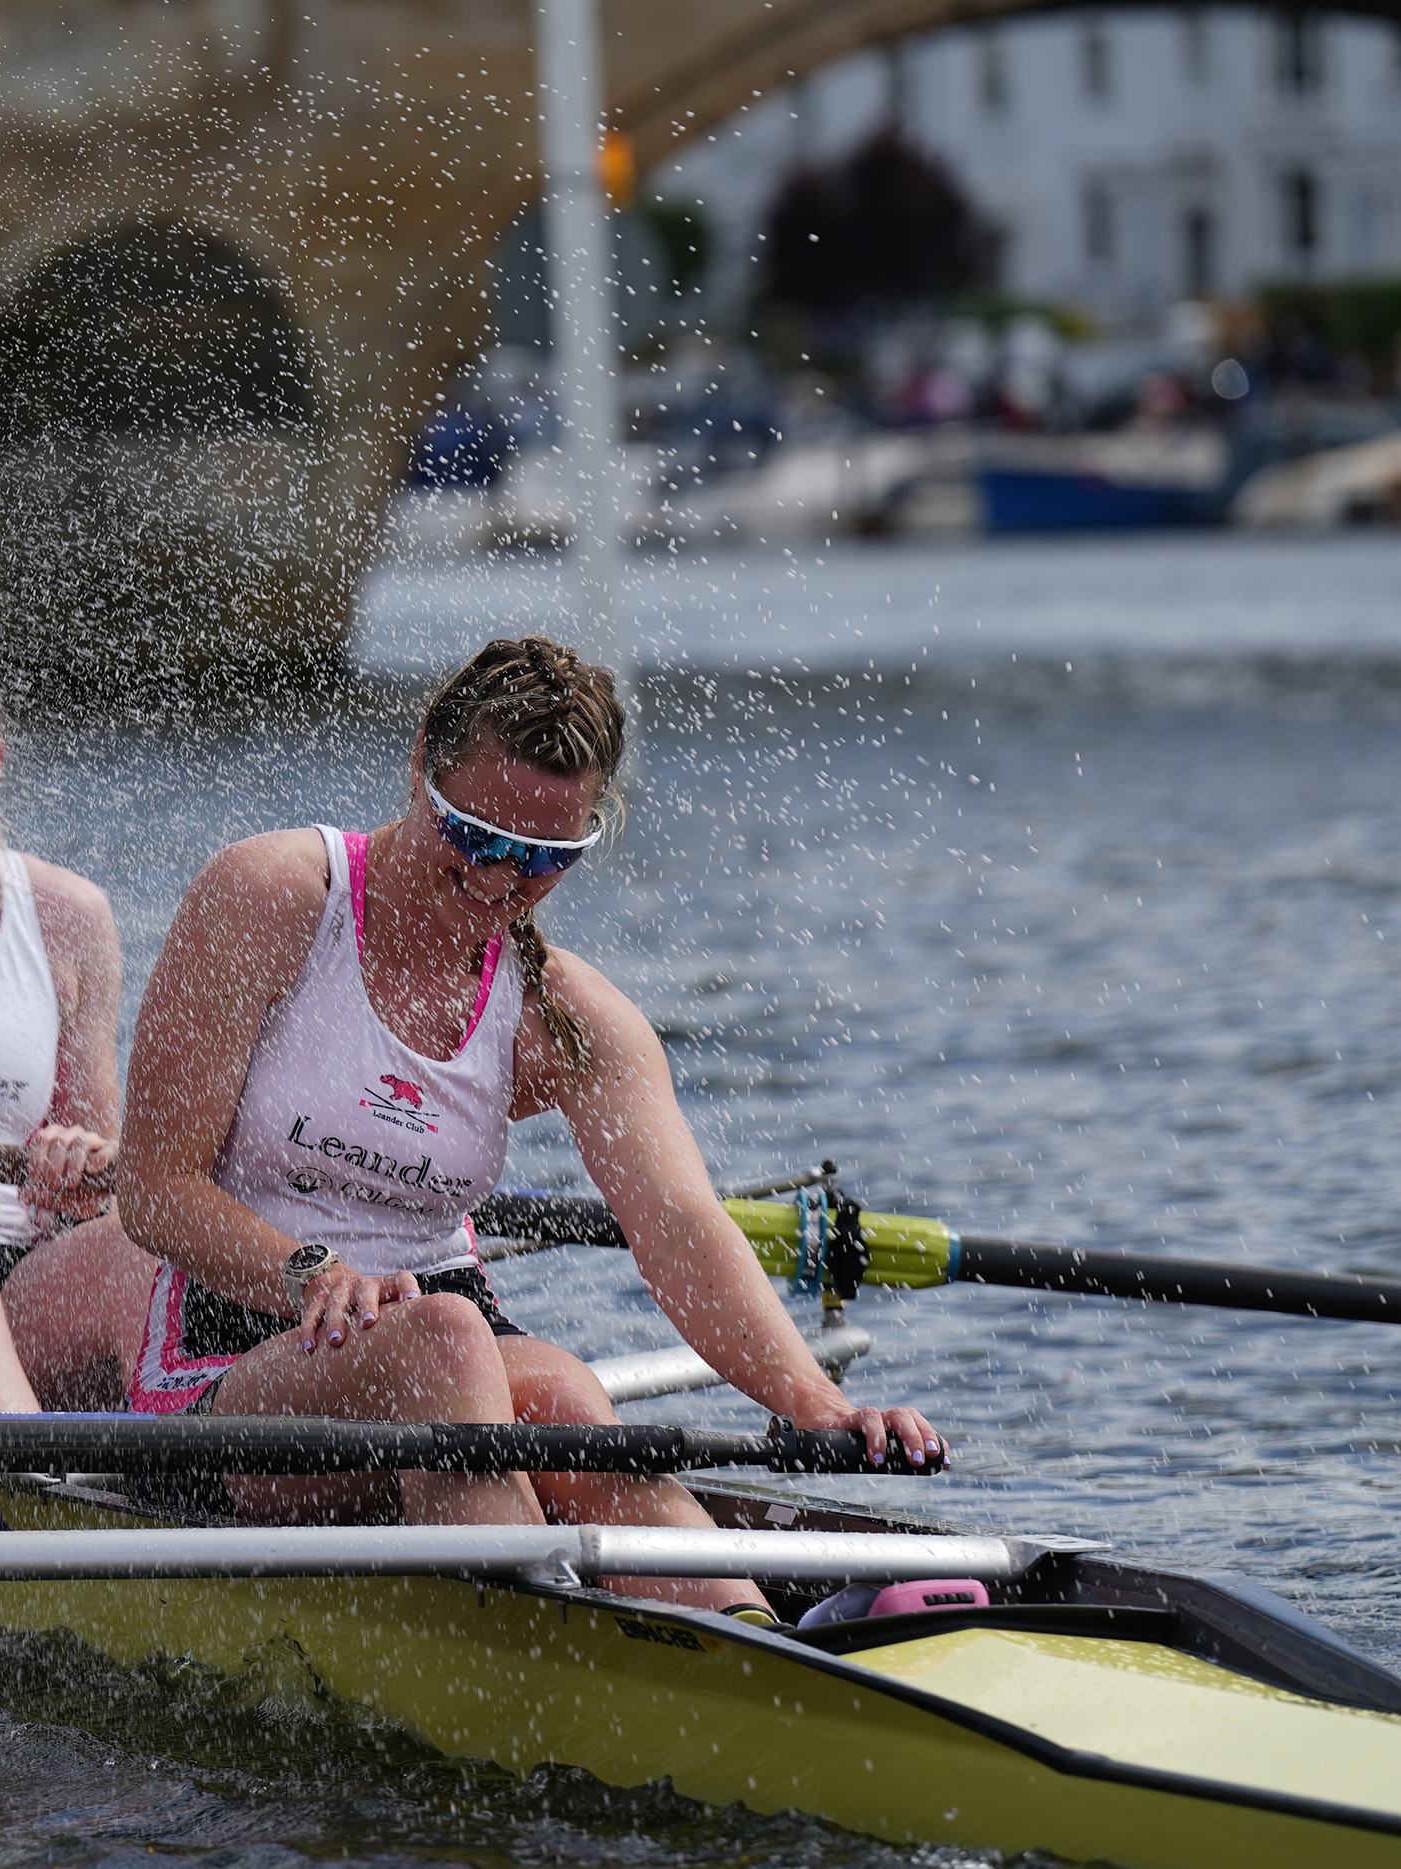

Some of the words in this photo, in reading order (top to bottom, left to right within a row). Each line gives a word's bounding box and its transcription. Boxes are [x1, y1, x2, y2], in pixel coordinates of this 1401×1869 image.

[373, 1109, 404, 1126] Leander
[405, 1121, 425, 1134] Club
[287, 1112, 476, 1198] Leander
[613, 1616, 707, 1653] EMPACHER
